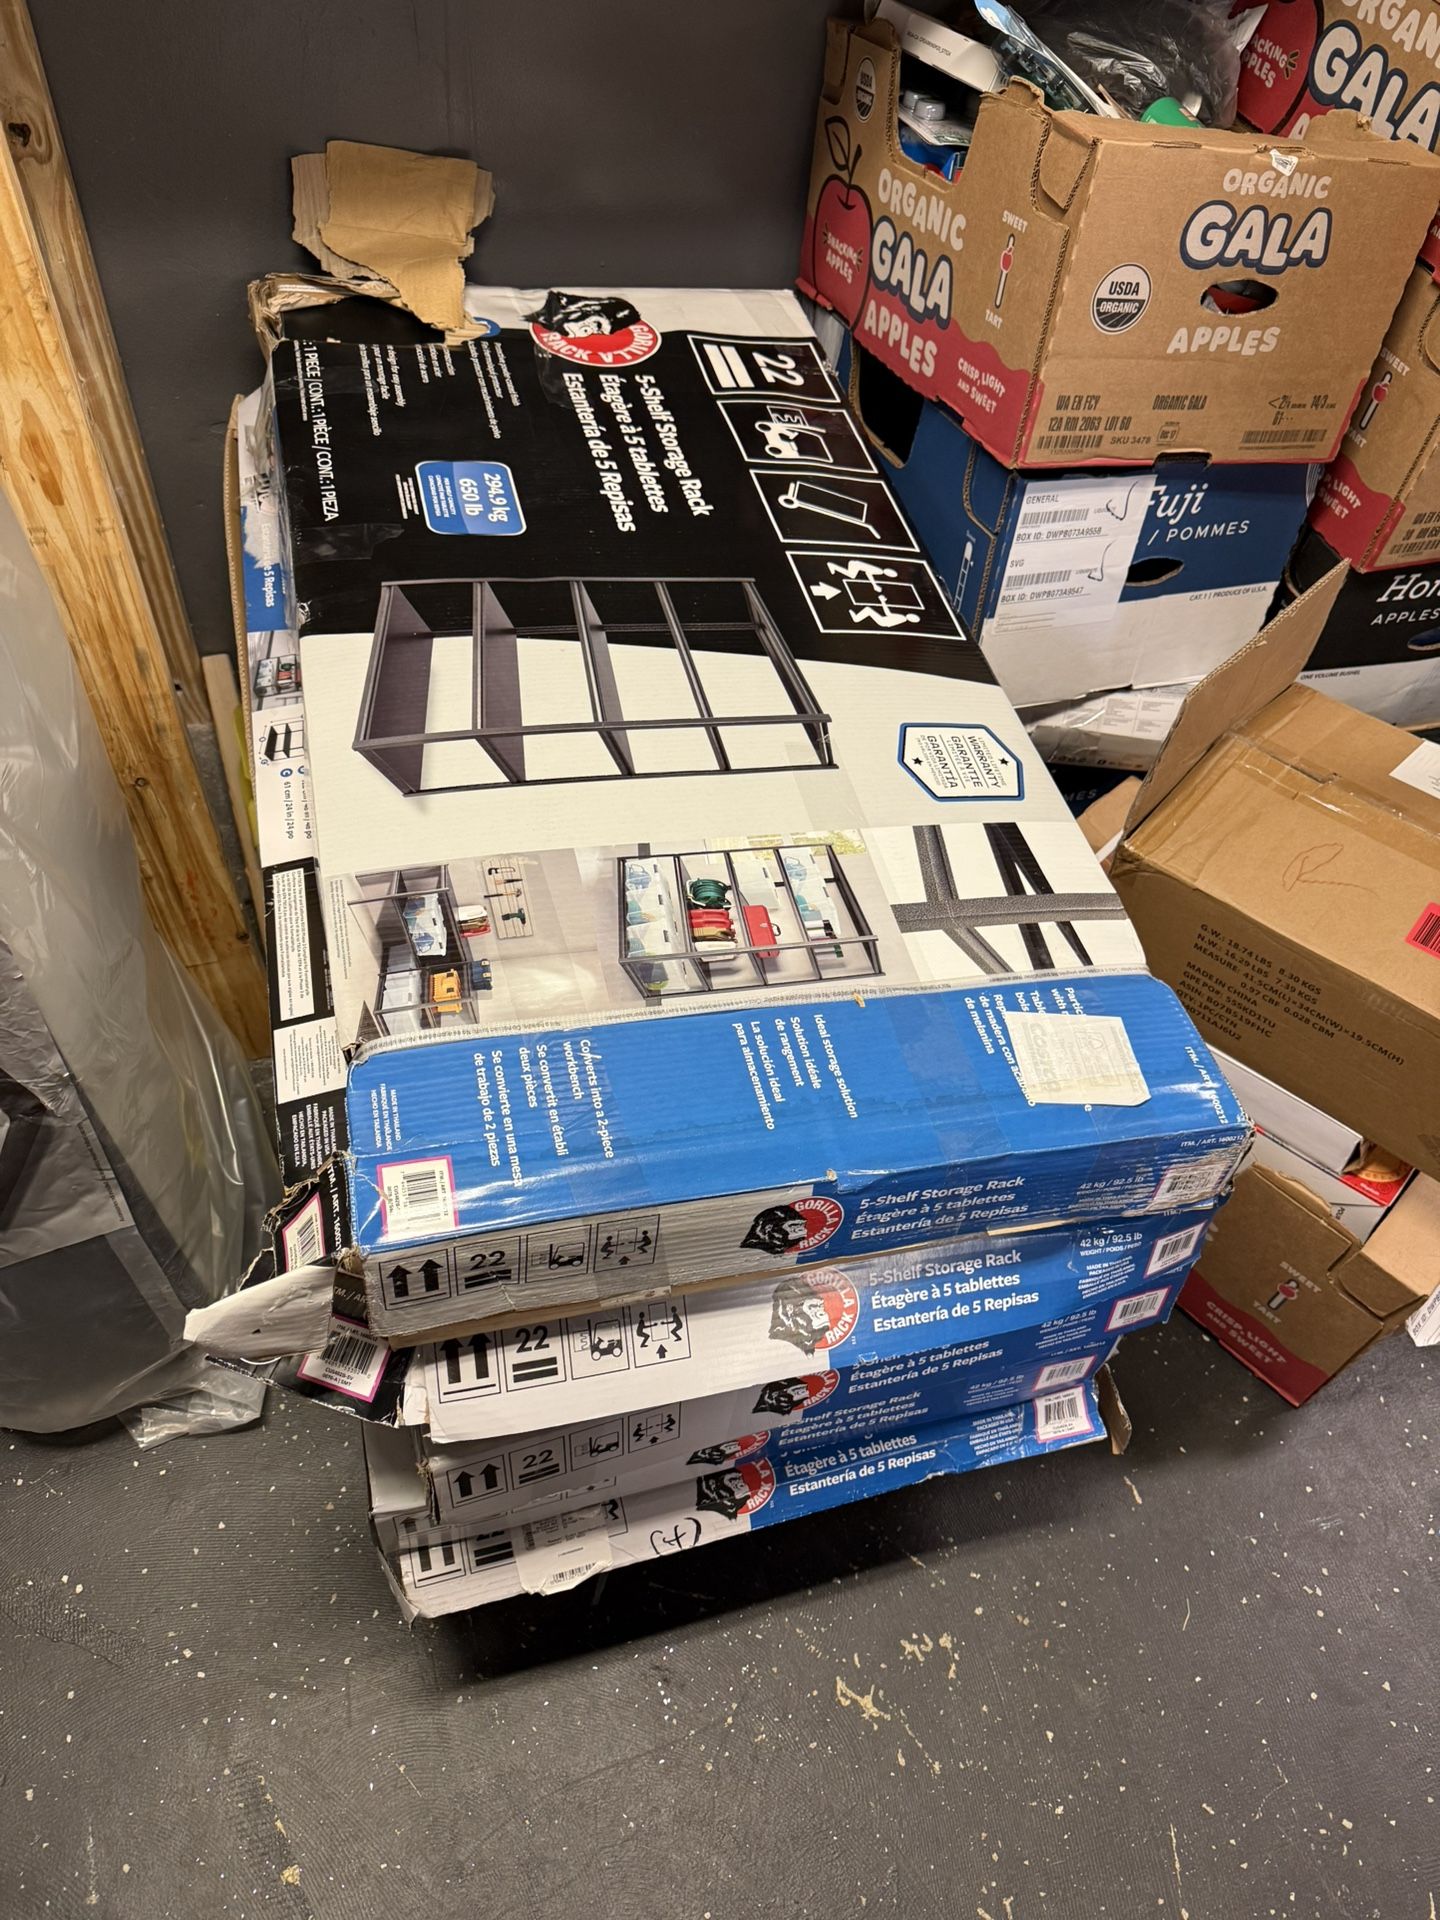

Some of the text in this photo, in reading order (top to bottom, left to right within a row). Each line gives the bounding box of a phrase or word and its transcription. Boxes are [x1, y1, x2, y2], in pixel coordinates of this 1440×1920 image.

[1310, 20, 1440, 152] GALA
[1223, 167, 1333, 200] ORGANIC
[878, 167, 967, 252] ORGANIC
[1002, 209, 1030, 234] SWEET
[1181, 200, 1333, 275] GALA
[825, 248, 854, 285] APPLES
[872, 216, 953, 330] GALA
[1099, 301, 1140, 314] ORGANIC
[1108, 281, 1140, 297] USDA
[984, 308, 1004, 330] TART
[540, 331, 593, 362] RACK
[598, 324, 655, 364] GORILLA
[864, 299, 938, 379] APPLES
[1166, 326, 1281, 356] APPLES
[752, 351, 804, 387] 22
[957, 357, 1006, 399] CRISP, LIGHT
[1381, 347, 1410, 377] SWEET
[957, 378, 998, 414] AND SWEET
[600, 373, 669, 514] Étagère à 5 tablettes
[635, 374, 714, 517] 5-Shelf Storage Rack
[459, 478, 484, 517] 650 lb
[484, 472, 510, 523] 294.9 kg
[1026, 494, 1059, 505] GENERAL
[1148, 482, 1209, 525] Fuji
[1333, 479, 1362, 510] LIGHT
[1166, 520, 1250, 543] POMMES
[1010, 559, 1025, 569] SVG
[1001, 594, 1016, 604] BOX
[1370, 607, 1440, 626] APPLES
[926, 735, 959, 789] GARANTÍA
[950, 735, 983, 788] GARANTIE
[968, 735, 1002, 789] WARRANTY
[1192, 943, 1241, 973] MEASURE:
[1200, 923, 1225, 942] G.W.:
[1254, 954, 1273, 969] LBS
[1301, 979, 1322, 996] KGS
[1014, 991, 1030, 1013] bois
[1186, 961, 1258, 1007] MADE IN CHINA
[1250, 963, 1270, 979] LBS
[1275, 977, 1297, 993] 7.39
[1297, 990, 1318, 1006] KGS
[979, 995, 1016, 1065] de madera con
[491, 1049, 503, 1064] Se
[562, 1041, 585, 1100] workbench
[750, 1021, 787, 1103] La solución ideal
[774, 1018, 805, 1088] de rangement
[813, 1013, 860, 1120] Ideal storage solution
[494, 1065, 512, 1117] convierte
[518, 1046, 539, 1109] deux pièces
[731, 1022, 776, 1131] para almacenamiento
[804, 1058, 822, 1090] idéale
[473, 1052, 501, 1167] de trabajo de 2 piezas
[536, 1043, 570, 1157] Se convertit en établi
[579, 1039, 614, 1159] Converts into a 2-piece
[319, 1110, 330, 1137] PACKAGED
[503, 1116, 514, 1132] en
[505, 1131, 518, 1155] una
[860, 1175, 1026, 1210] 5-Shelf Storage Rack
[794, 1198, 839, 1227] GORILLA
[850, 1203, 1029, 1241] Estantería de 5 Repisas
[1080, 1238, 1092, 1248] 42
[1093, 1236, 1106, 1247] kg
[1111, 1234, 1132, 1244] 92.5
[1133, 1231, 1143, 1241] lb
[469, 1250, 506, 1271] 22
[869, 1250, 1022, 1287] 5-Shelf Storage Rack
[1280, 1261, 1322, 1293] SWEET
[806, 1272, 855, 1309] GORILLA
[871, 1273, 1021, 1311] Étagère à 5 tablettes
[824, 1309, 856, 1345] RACK
[873, 1290, 1039, 1333] Estantería de 5 Repisas
[1253, 1299, 1281, 1324] TART
[514, 1325, 549, 1353] 22
[1228, 1328, 1273, 1364] SWEET
[1246, 1330, 1287, 1363] LIGHT
[835, 1390, 922, 1416] Storage Rack
[522, 1449, 553, 1469] 22
[784, 1432, 918, 1479] Étagère à 5 tablettes
[789, 1447, 937, 1497] Estantería de 5 Repisas
[745, 1480, 773, 1509] RACK
